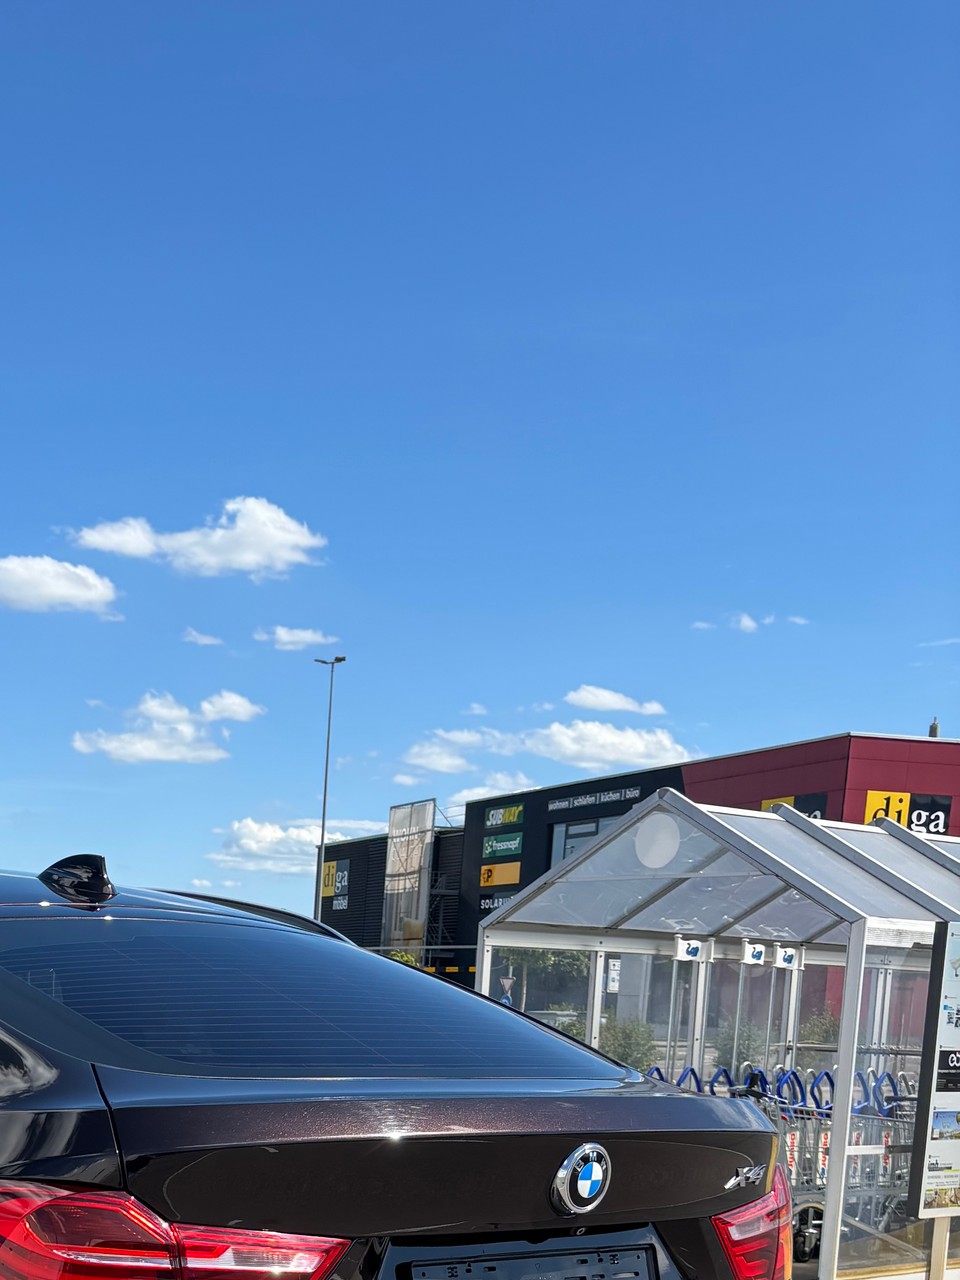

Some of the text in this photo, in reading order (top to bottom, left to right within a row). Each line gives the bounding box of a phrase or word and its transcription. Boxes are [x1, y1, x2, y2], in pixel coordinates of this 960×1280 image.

[486, 805, 523, 826] SUBWAY
[548, 800, 569, 811] wohnen
[872, 796, 946, 833] diga
[492, 837, 520, 851] fressnapf
[324, 865, 348, 893] diga
[575, 1152, 607, 1172] BMW
[724, 1164, 767, 1189] X4
